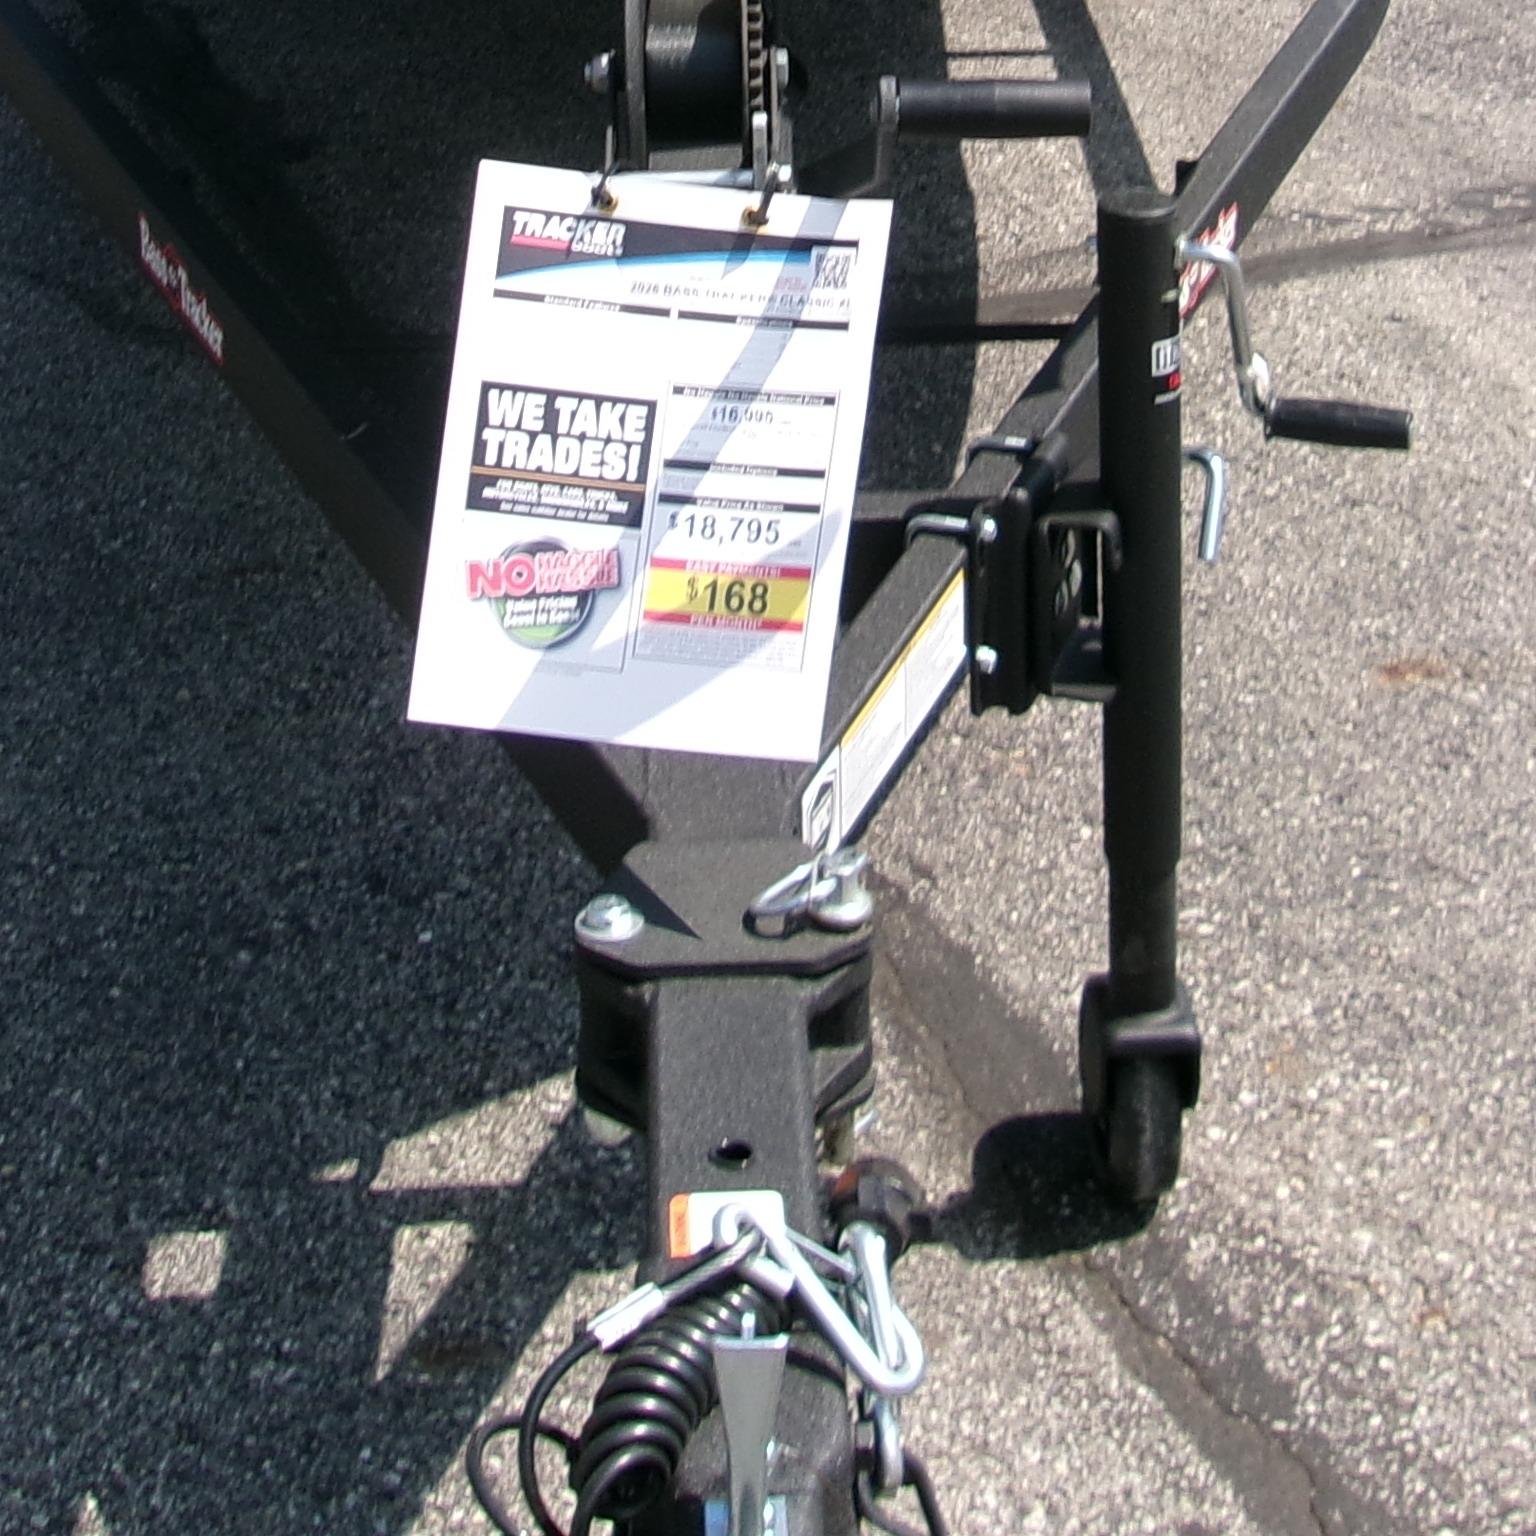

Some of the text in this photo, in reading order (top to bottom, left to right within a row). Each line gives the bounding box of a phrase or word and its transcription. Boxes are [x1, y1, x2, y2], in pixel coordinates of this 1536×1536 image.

[513, 210, 627, 249] TRACKER
[487, 387, 649, 443] WE TAKE
[481, 427, 642, 482] TRADES!
[668, 510, 782, 546] $18,795
[465, 552, 536, 601] NO
[687, 574, 769, 615] $168
